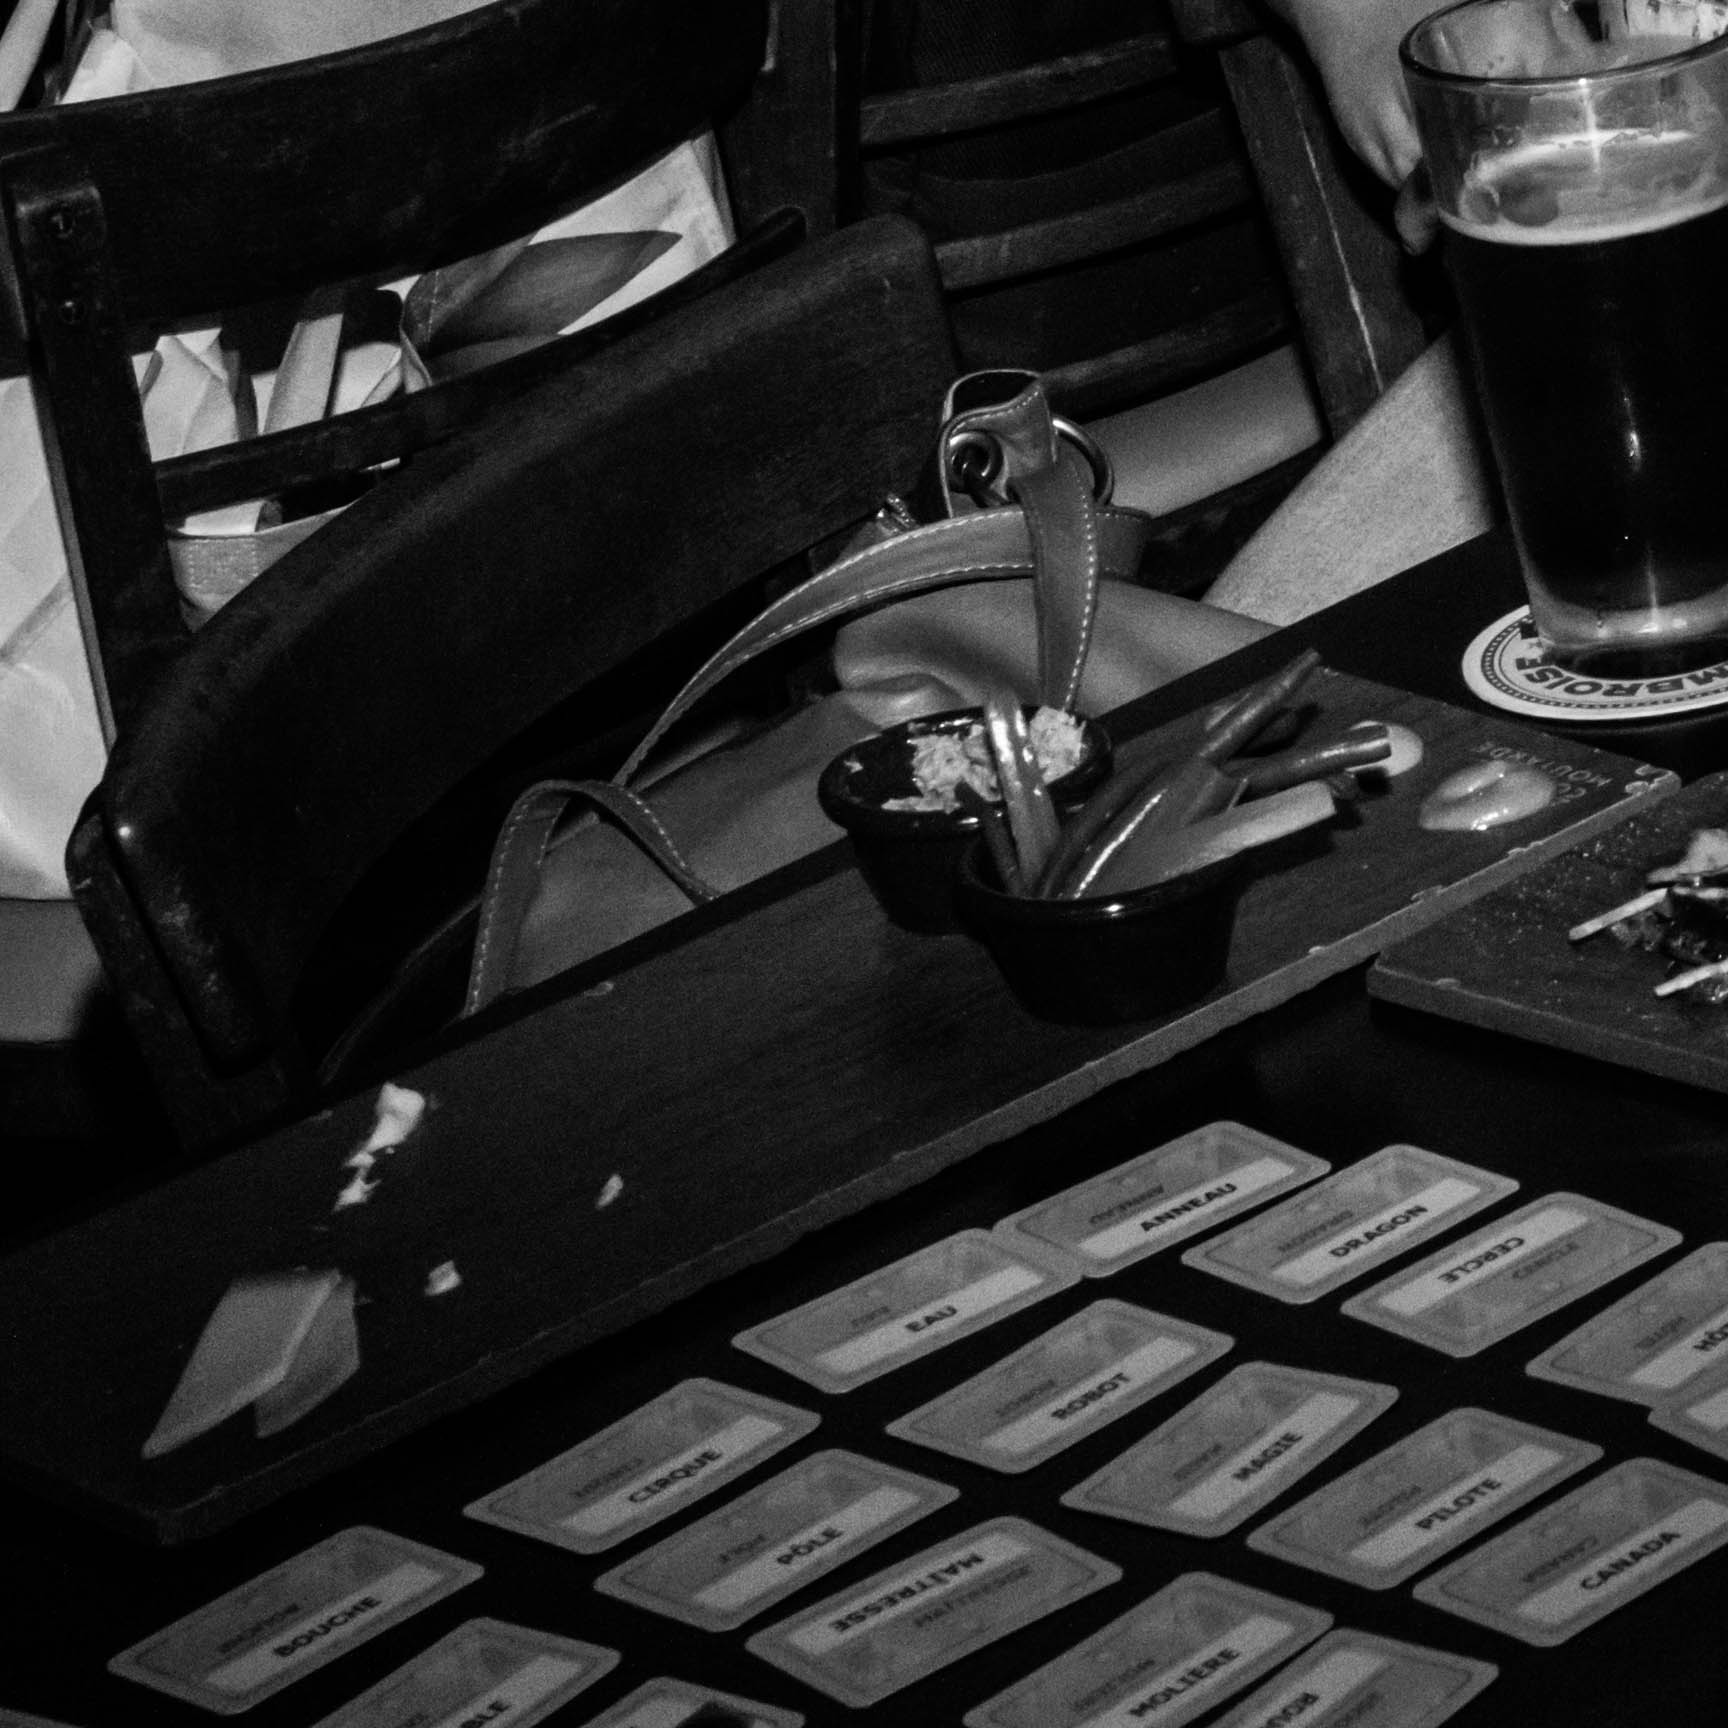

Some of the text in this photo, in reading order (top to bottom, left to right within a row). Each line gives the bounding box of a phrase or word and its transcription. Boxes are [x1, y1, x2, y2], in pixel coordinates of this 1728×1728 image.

[1141, 1183, 1237, 1232] ANNEAU
[1331, 1205, 1428, 1257] DRAGON
[1438, 1237, 1525, 1284] CERCLE
[904, 1305, 958, 1332] EAU
[1051, 1372, 1131, 1420] ROBOT
[629, 1450, 722, 1503] CIRQUE
[1232, 1432, 1303, 1482] MAGIE
[1415, 1477, 1502, 1530] PILOTE
[1581, 1530, 1682, 1590] CANADA
[273, 1596, 382, 1658] BOUCHE
